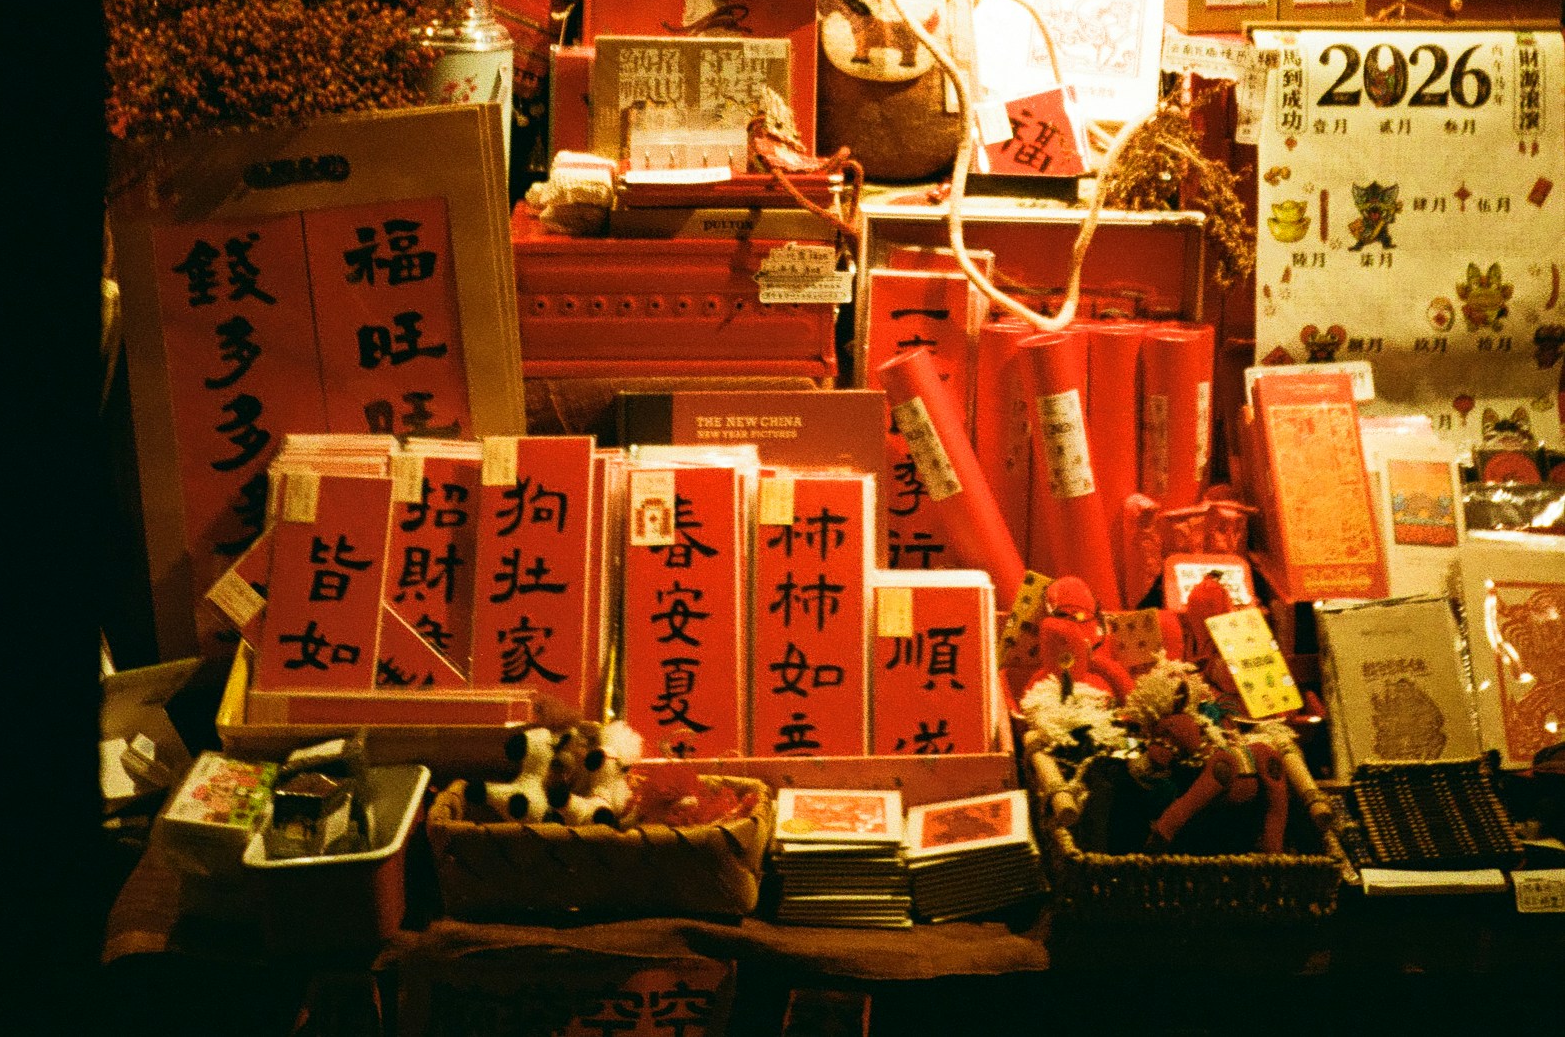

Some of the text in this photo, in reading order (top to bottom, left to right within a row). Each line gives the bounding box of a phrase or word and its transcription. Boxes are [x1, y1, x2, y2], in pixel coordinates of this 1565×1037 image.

[1316, 43, 1492, 109] 2026
[695, 416, 803, 428] THE NEW CHINA
[696, 429, 798, 440] NEW YEAR PICTURES
